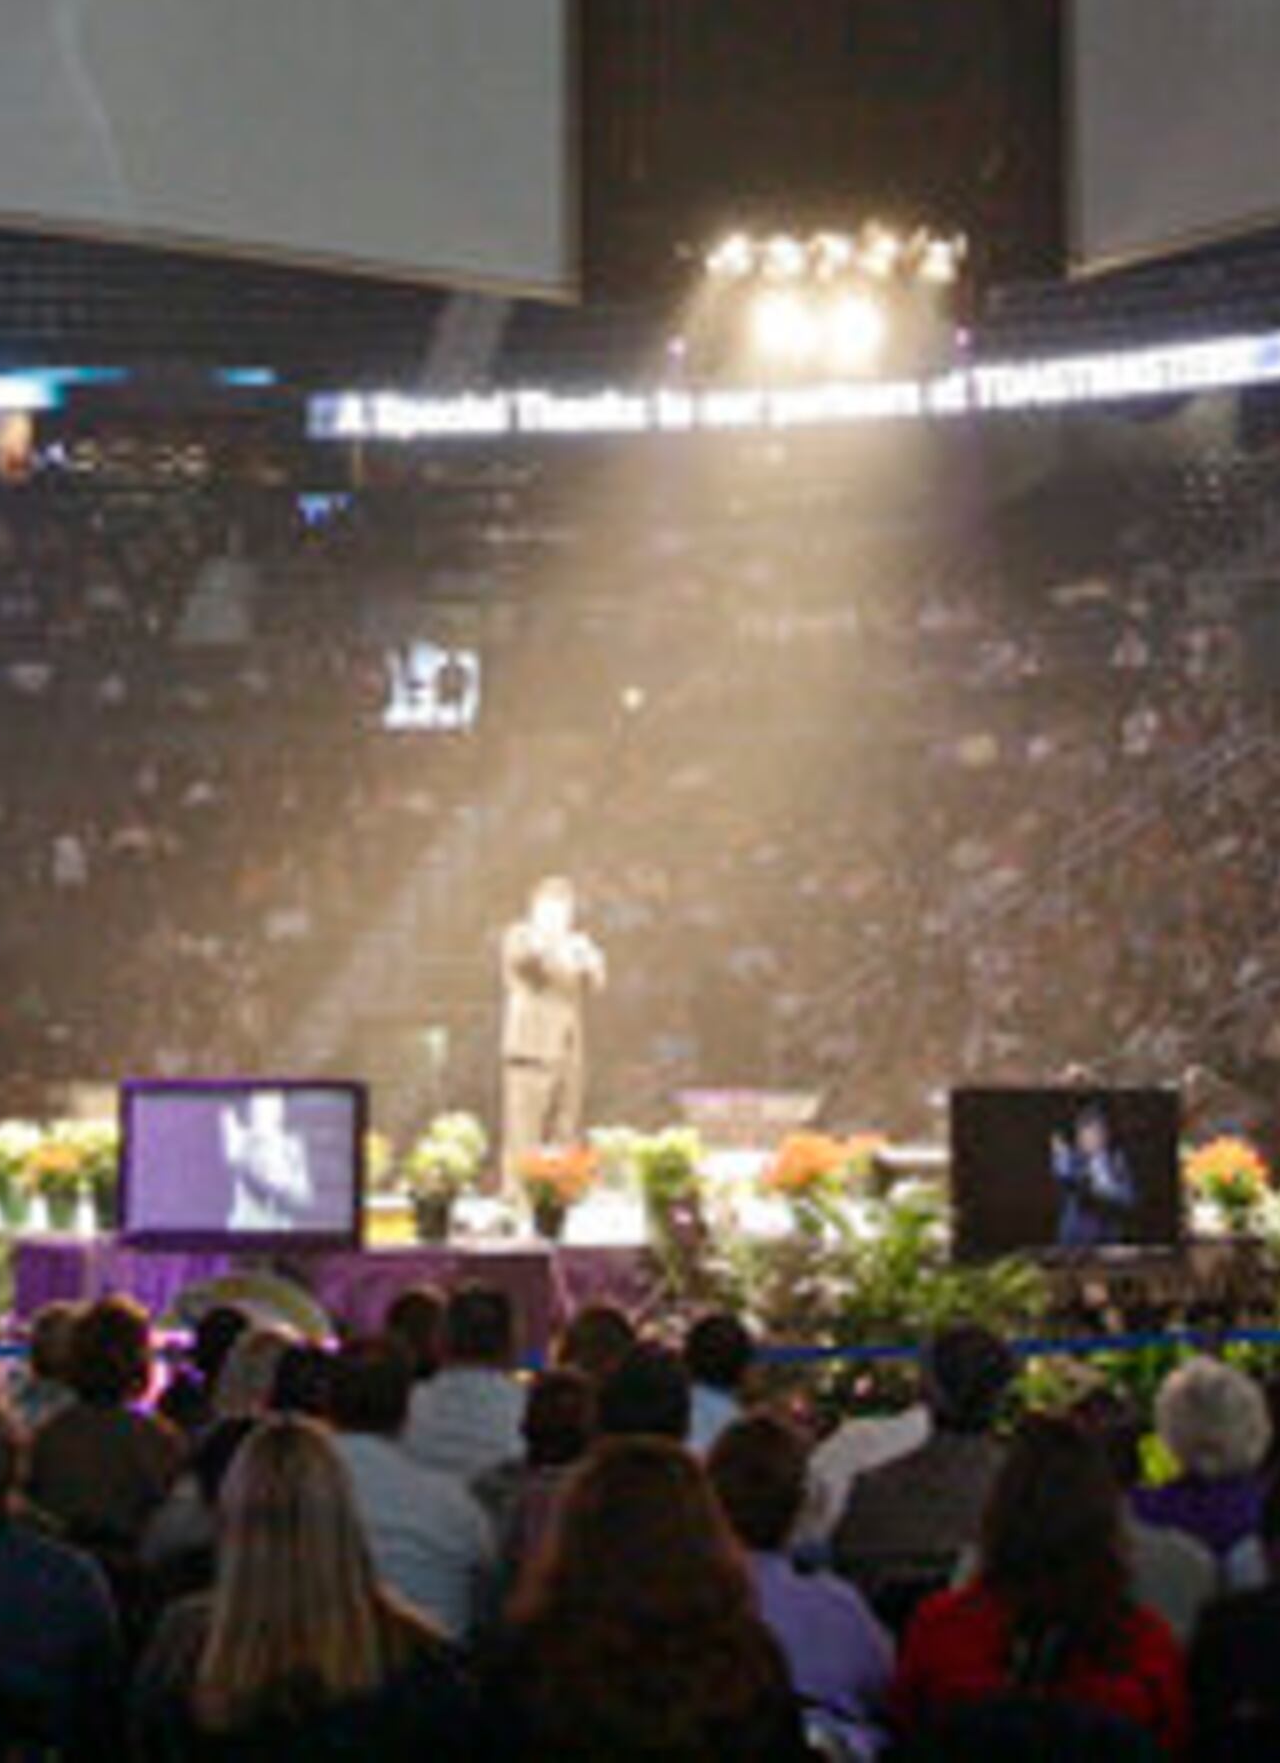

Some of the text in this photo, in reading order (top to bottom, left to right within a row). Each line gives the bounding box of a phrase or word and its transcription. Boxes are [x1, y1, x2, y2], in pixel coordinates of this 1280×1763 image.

[373, 395, 510, 439] Special
[516, 390, 648, 433] Thanks
[656, 389, 693, 429] to
[702, 385, 765, 429] our
[768, 377, 923, 426] partners
